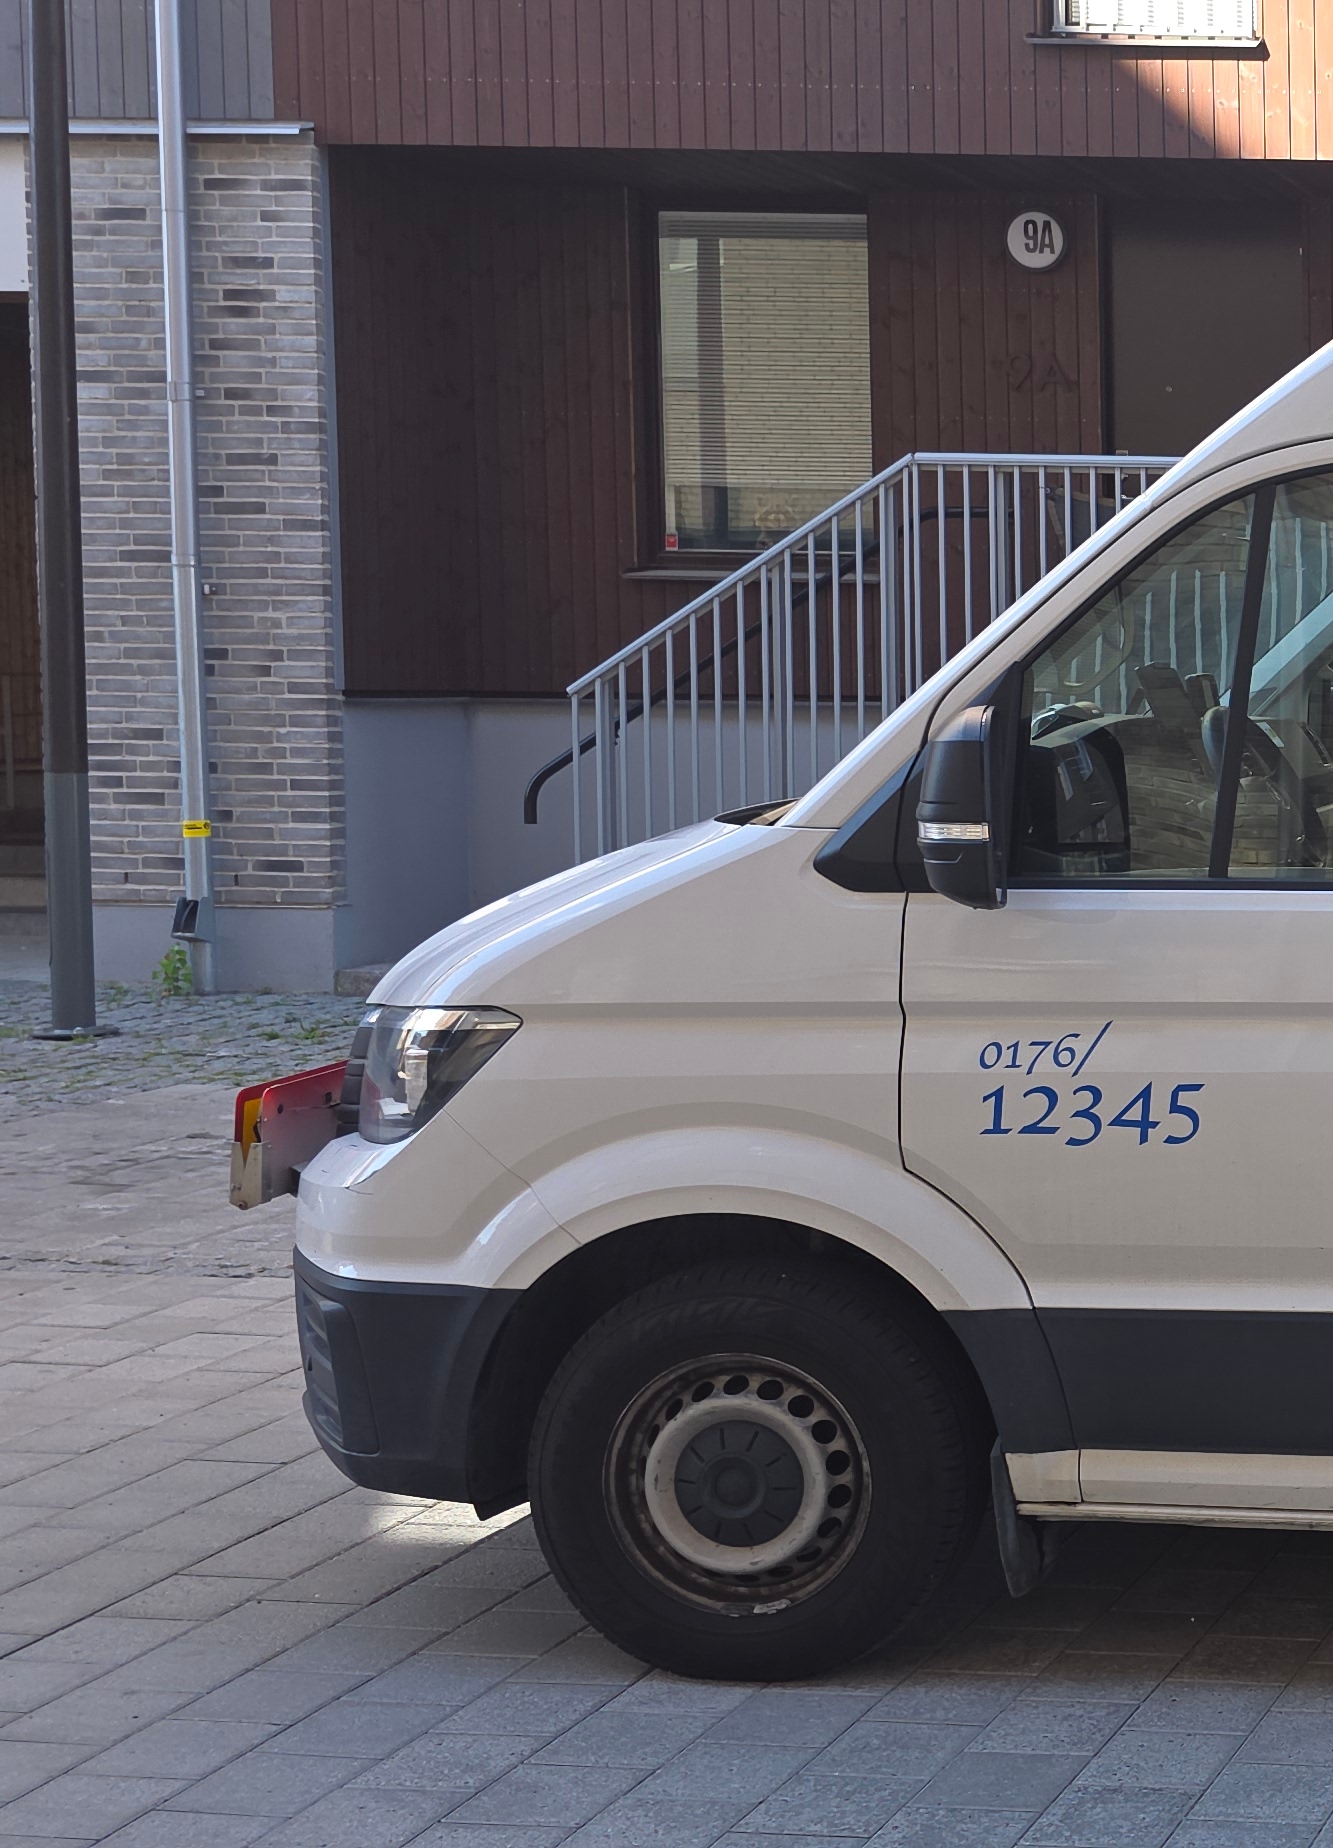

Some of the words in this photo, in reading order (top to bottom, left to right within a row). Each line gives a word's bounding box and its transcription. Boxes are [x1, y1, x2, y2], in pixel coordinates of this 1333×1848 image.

[1023, 219, 1055, 254] 9A
[1008, 350, 1075, 393] 9A
[979, 1019, 1115, 1079] 0176/
[979, 1080, 1206, 1147] 12345
